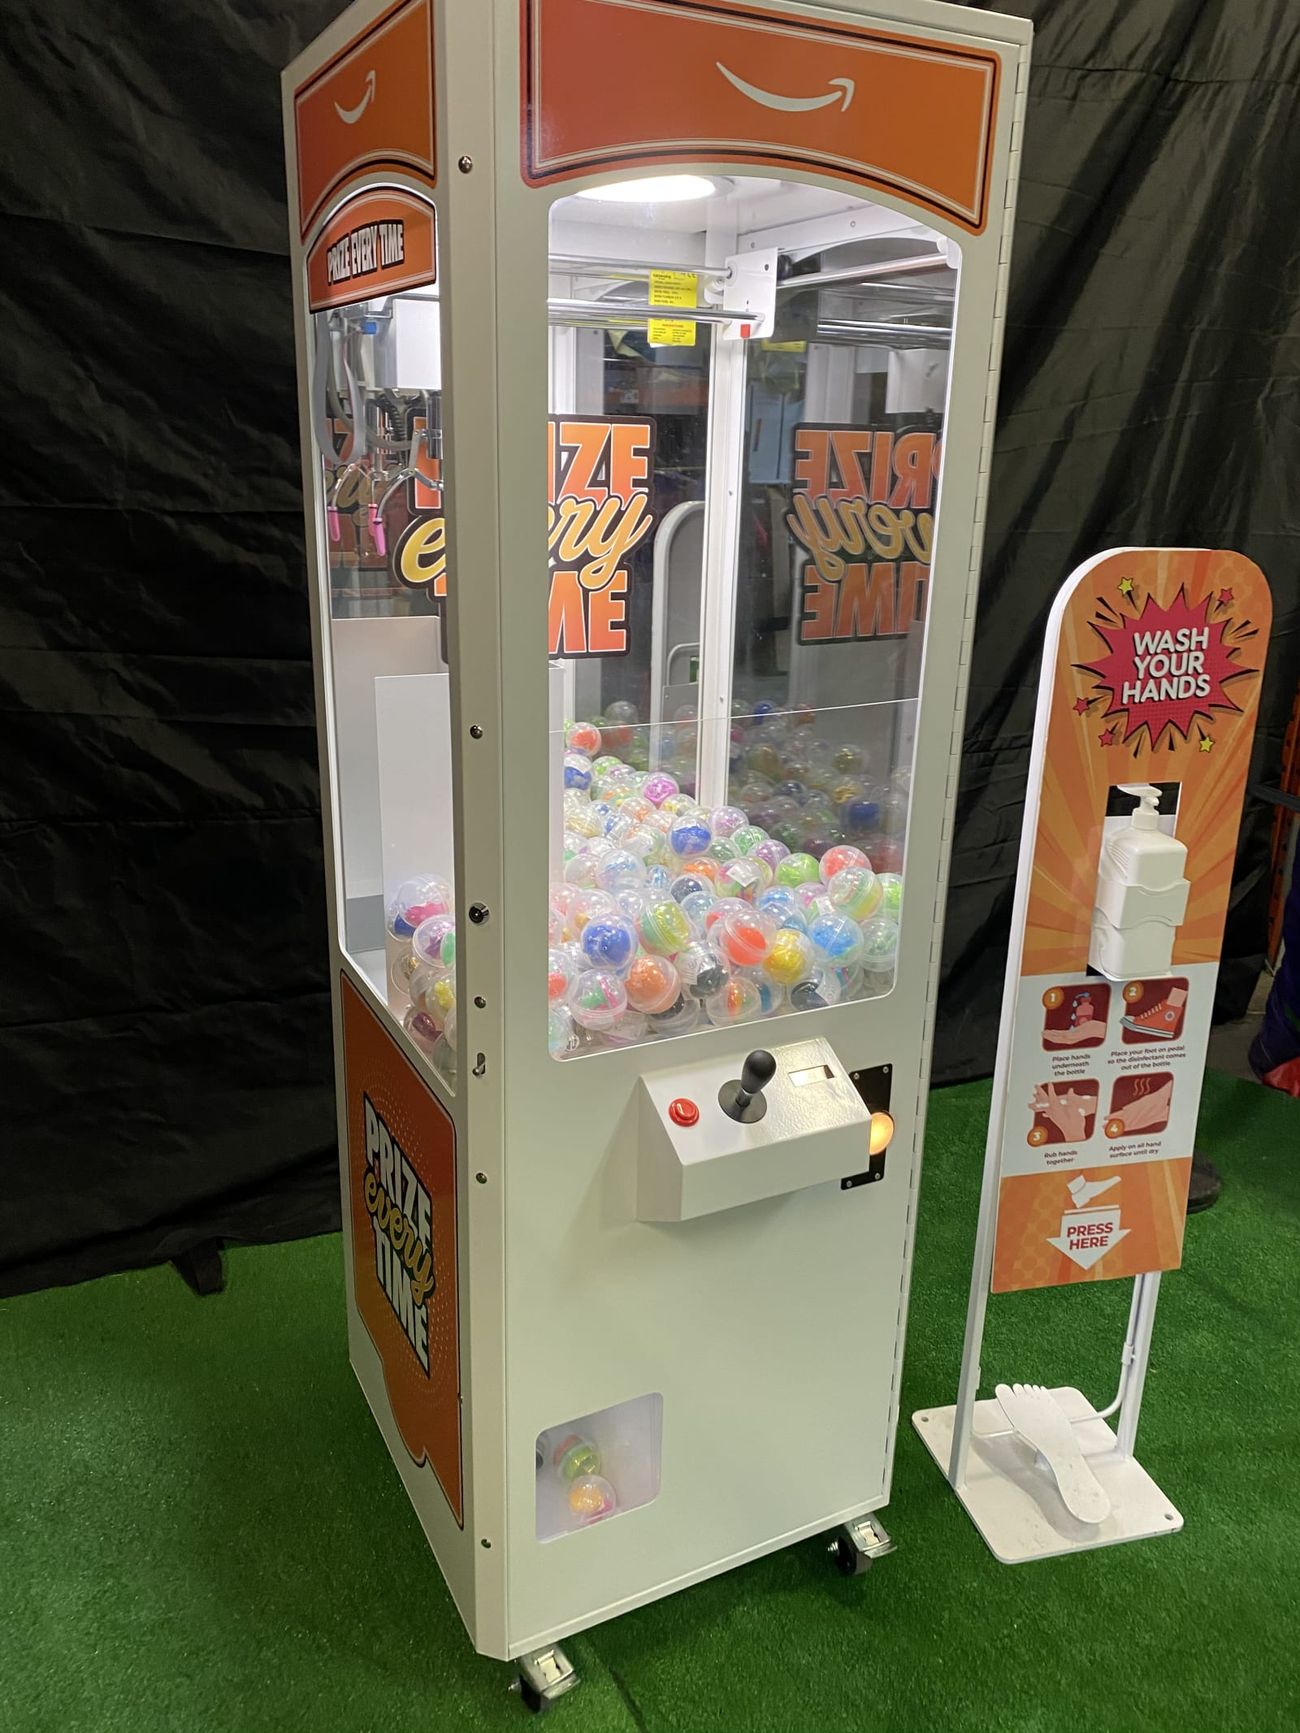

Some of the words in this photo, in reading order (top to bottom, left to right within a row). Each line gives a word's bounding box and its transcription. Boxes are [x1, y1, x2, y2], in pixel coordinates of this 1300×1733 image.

[327, 236, 351, 283] PRIZE
[351, 225, 378, 275] EVERY
[379, 223, 404, 266] TIME
[1133, 627, 1209, 655] WASH
[1134, 651, 1204, 679] YOUR
[1122, 674, 1210, 704] HANDS
[1050, 992, 1056, 1002] 1
[1130, 987, 1136, 996] 2
[1052, 1061, 1090, 1070] underneath
[1128, 1054, 1164, 1062] disinfectant
[1033, 1131, 1041, 1141] 3
[1110, 1124, 1118, 1133] 4
[364, 1094, 432, 1250] PRIZE
[1067, 1222, 1113, 1238] PRESS
[364, 1171, 434, 1306] every
[1069, 1235, 1109, 1250] HERE
[373, 1215, 428, 1371] TIME
